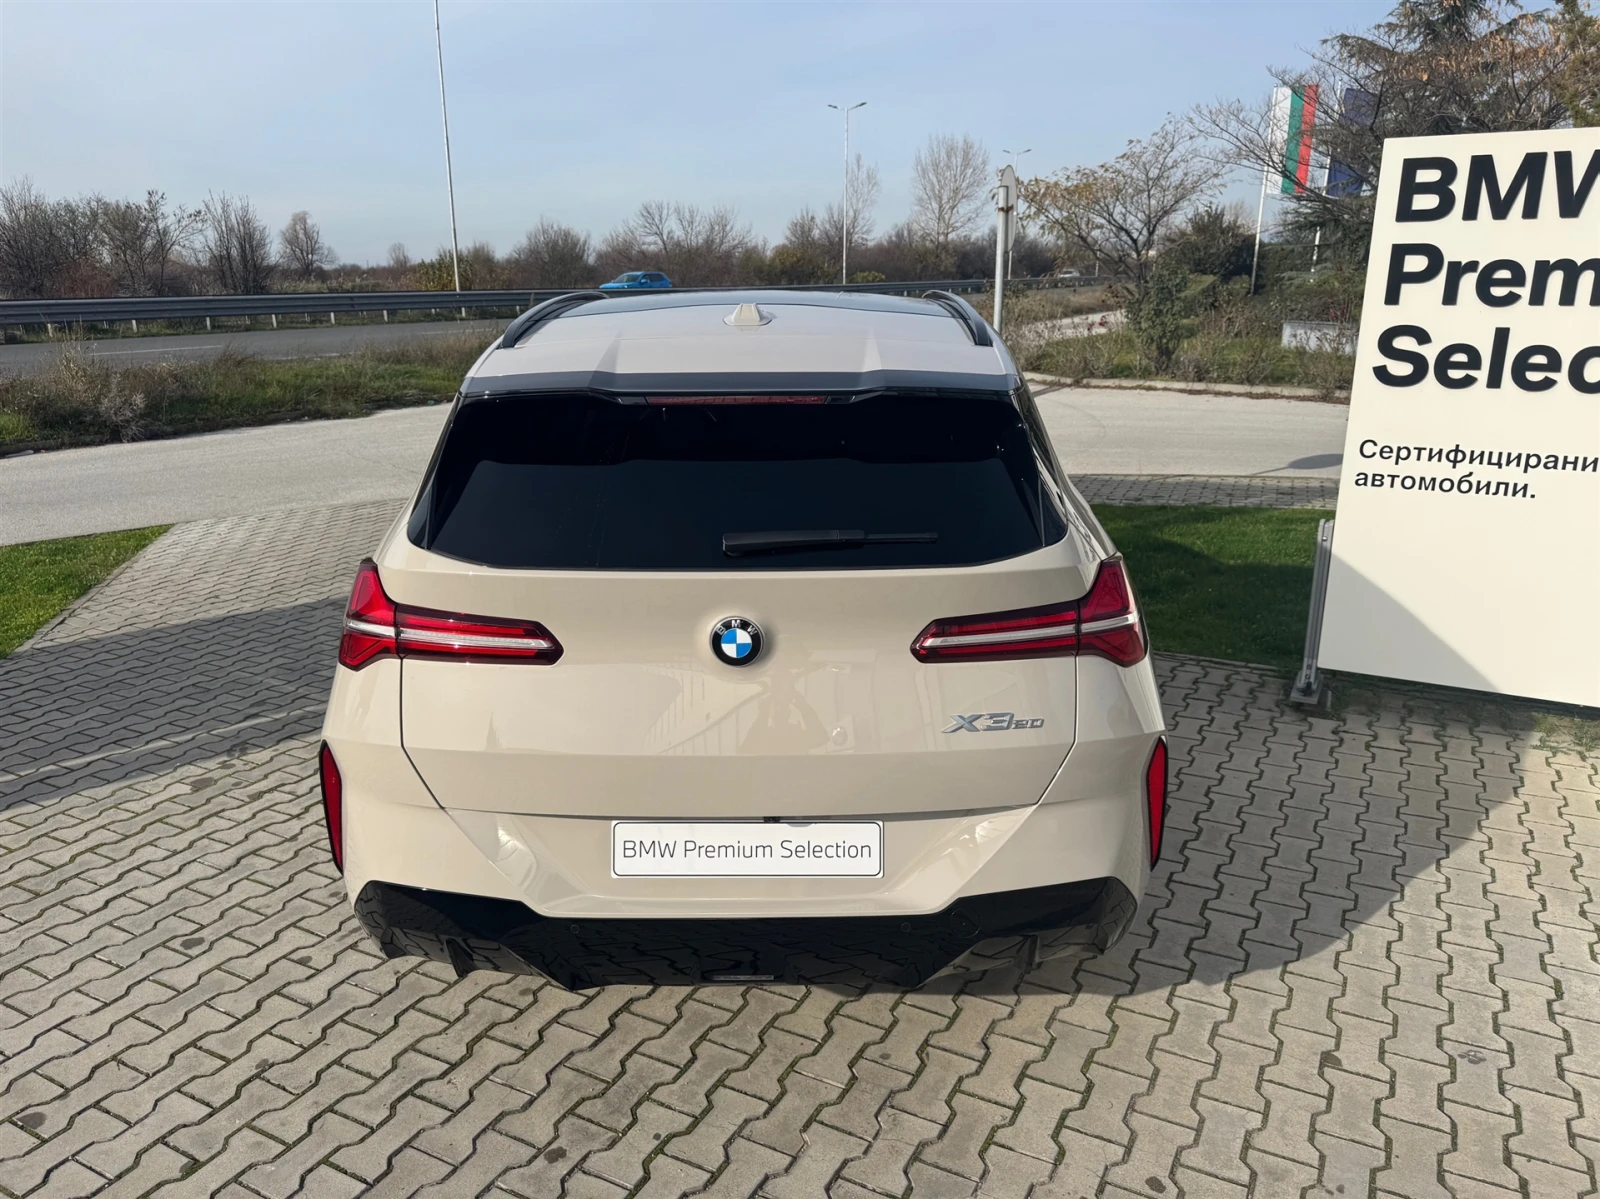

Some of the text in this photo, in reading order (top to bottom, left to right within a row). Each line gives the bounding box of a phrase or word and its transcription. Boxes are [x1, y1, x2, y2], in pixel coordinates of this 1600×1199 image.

[1383, 242, 1600, 308] Prem
[1358, 438, 1600, 474] Сертифицирани
[1354, 471, 1536, 499] автомобили.
[715, 619, 758, 636] BMW
[621, 839, 872, 859] BMW Premium Selection
